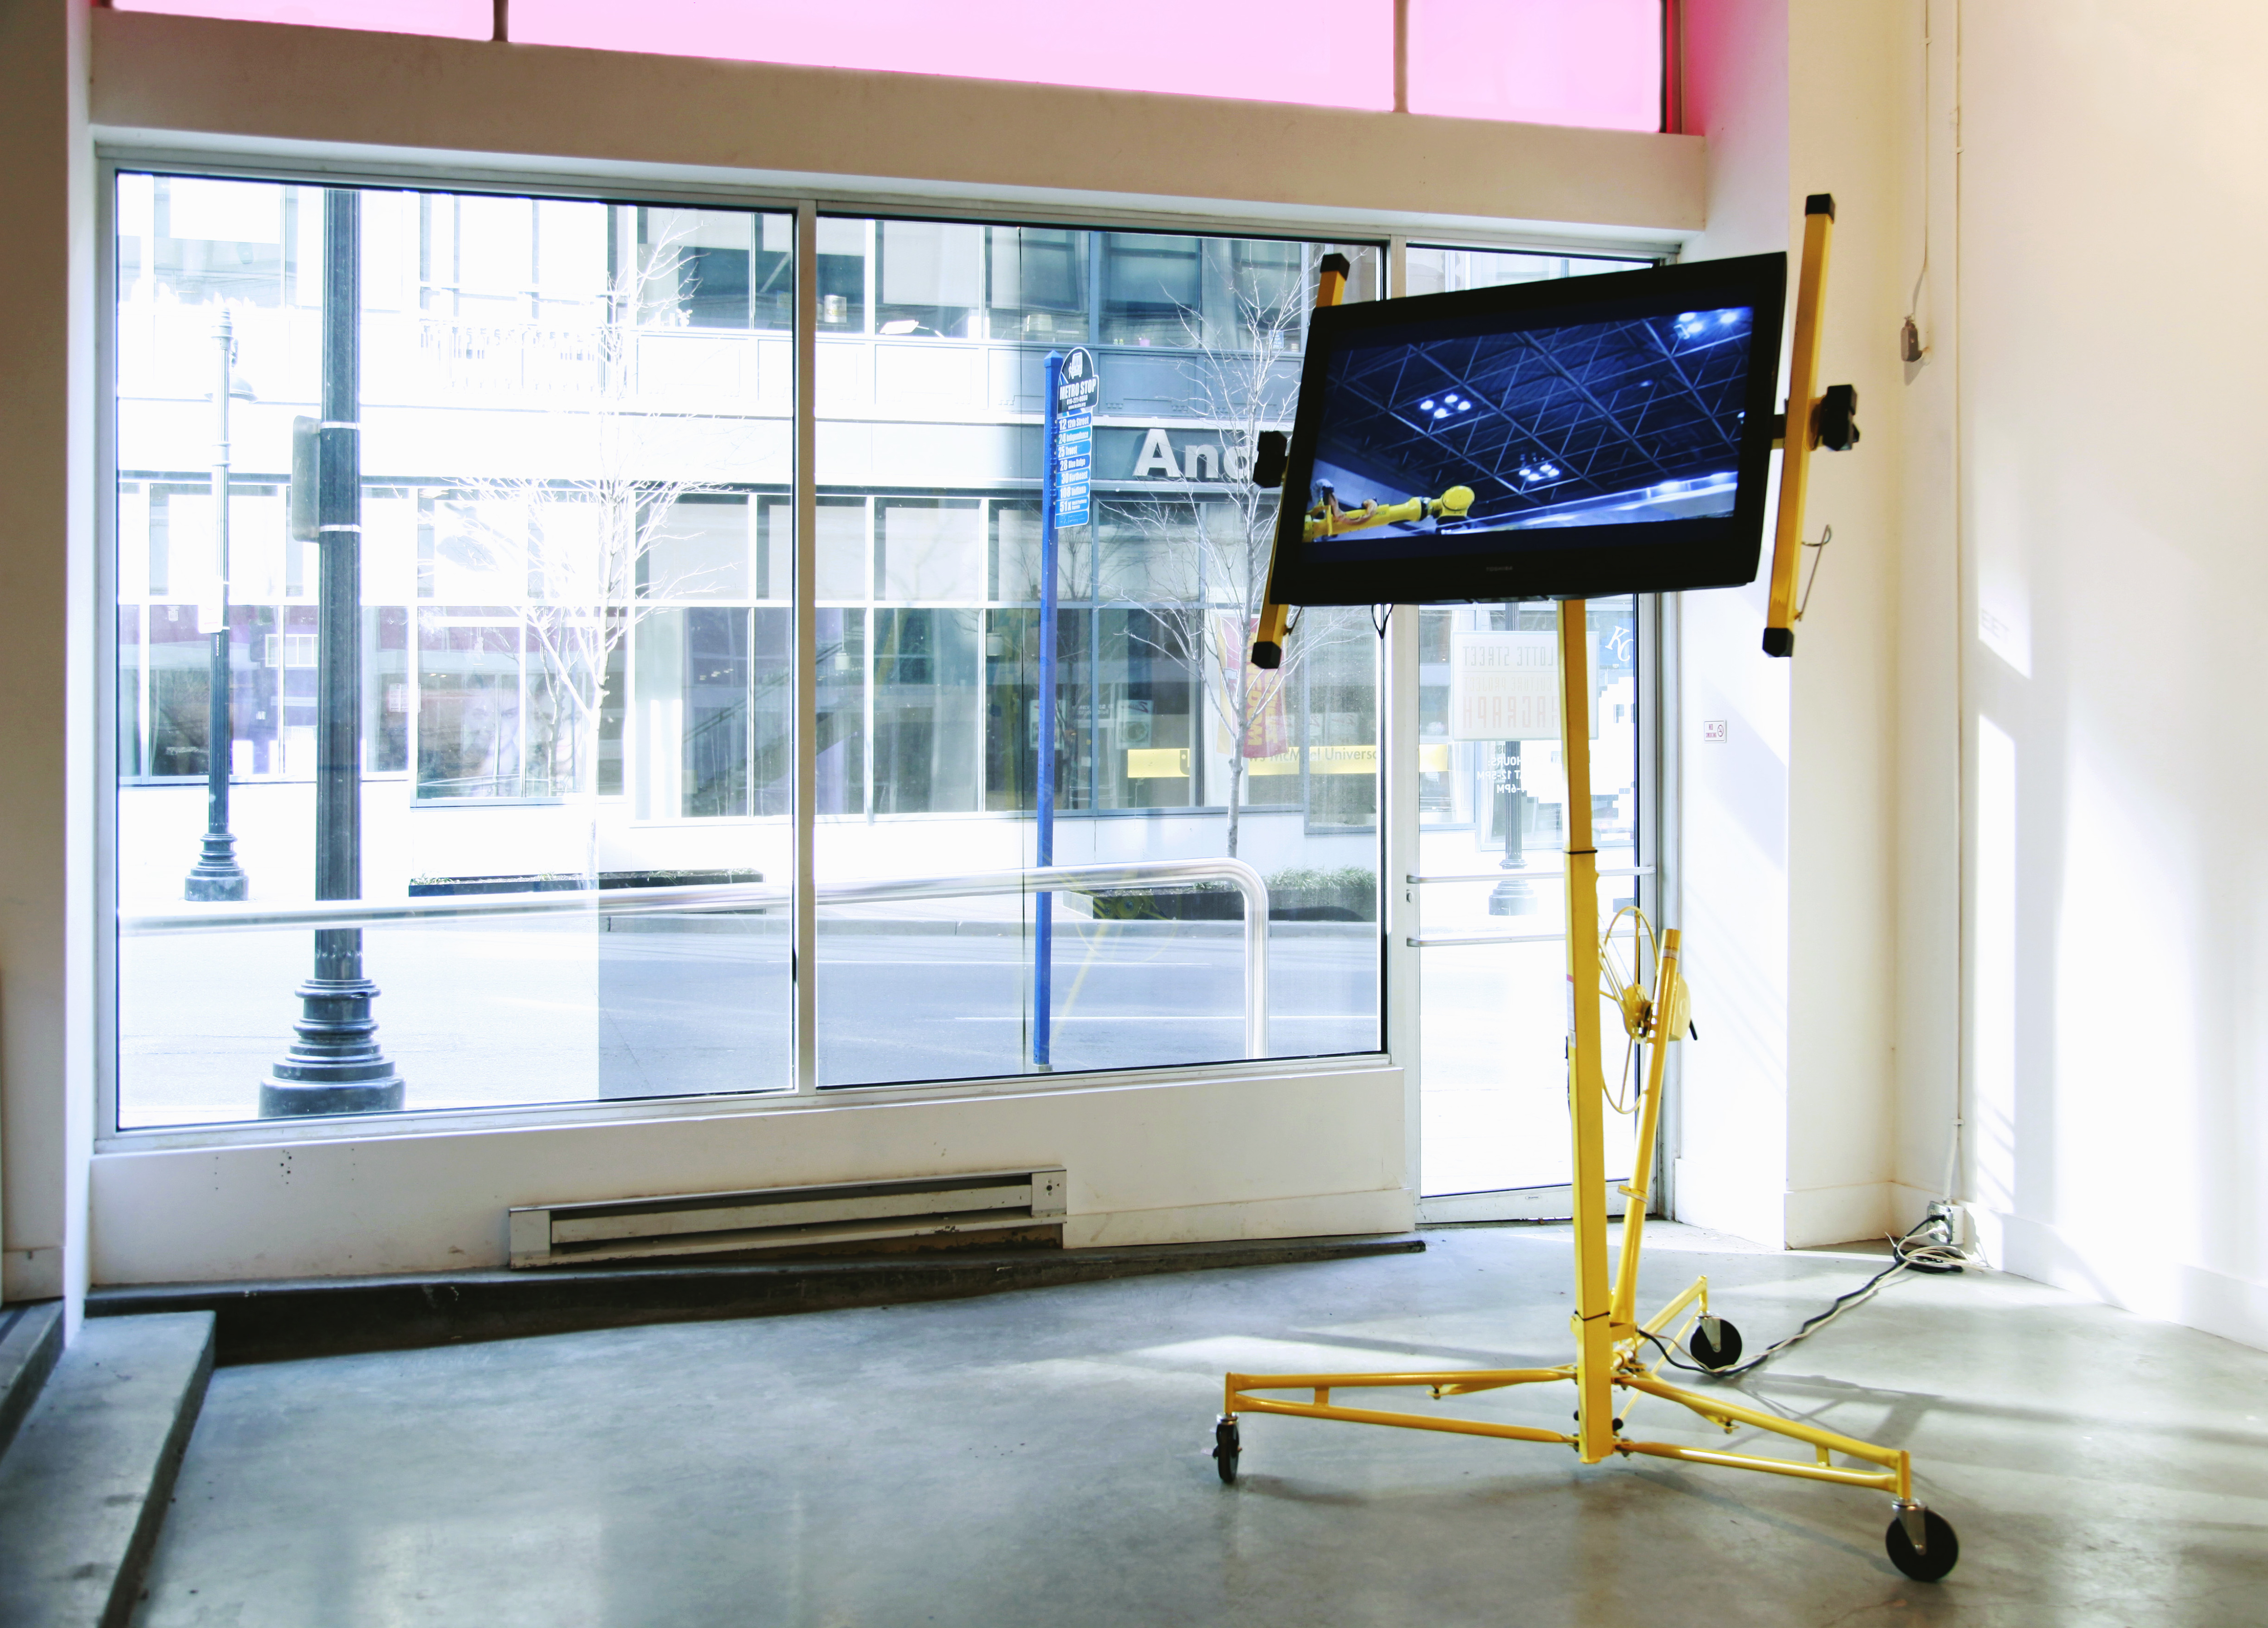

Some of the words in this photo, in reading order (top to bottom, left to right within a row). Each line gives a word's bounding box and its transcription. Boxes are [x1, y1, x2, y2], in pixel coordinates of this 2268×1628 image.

[1060, 382, 1079, 400] METRO
[1080, 378, 1096, 395] STOP
[1059, 419, 1067, 430] 12
[1067, 419, 1076, 429] 12th
[1076, 416, 1089, 426] Street
[1059, 433, 1066, 444] 24
[1058, 446, 1065, 458] 25
[1066, 445, 1077, 456] Troost
[1133, 429, 1259, 479] And
[1060, 459, 1068, 471] 28
[1061, 473, 1069, 484] 30
[1069, 470, 1088, 482] Northeast
[1060, 486, 1071, 498] 108
